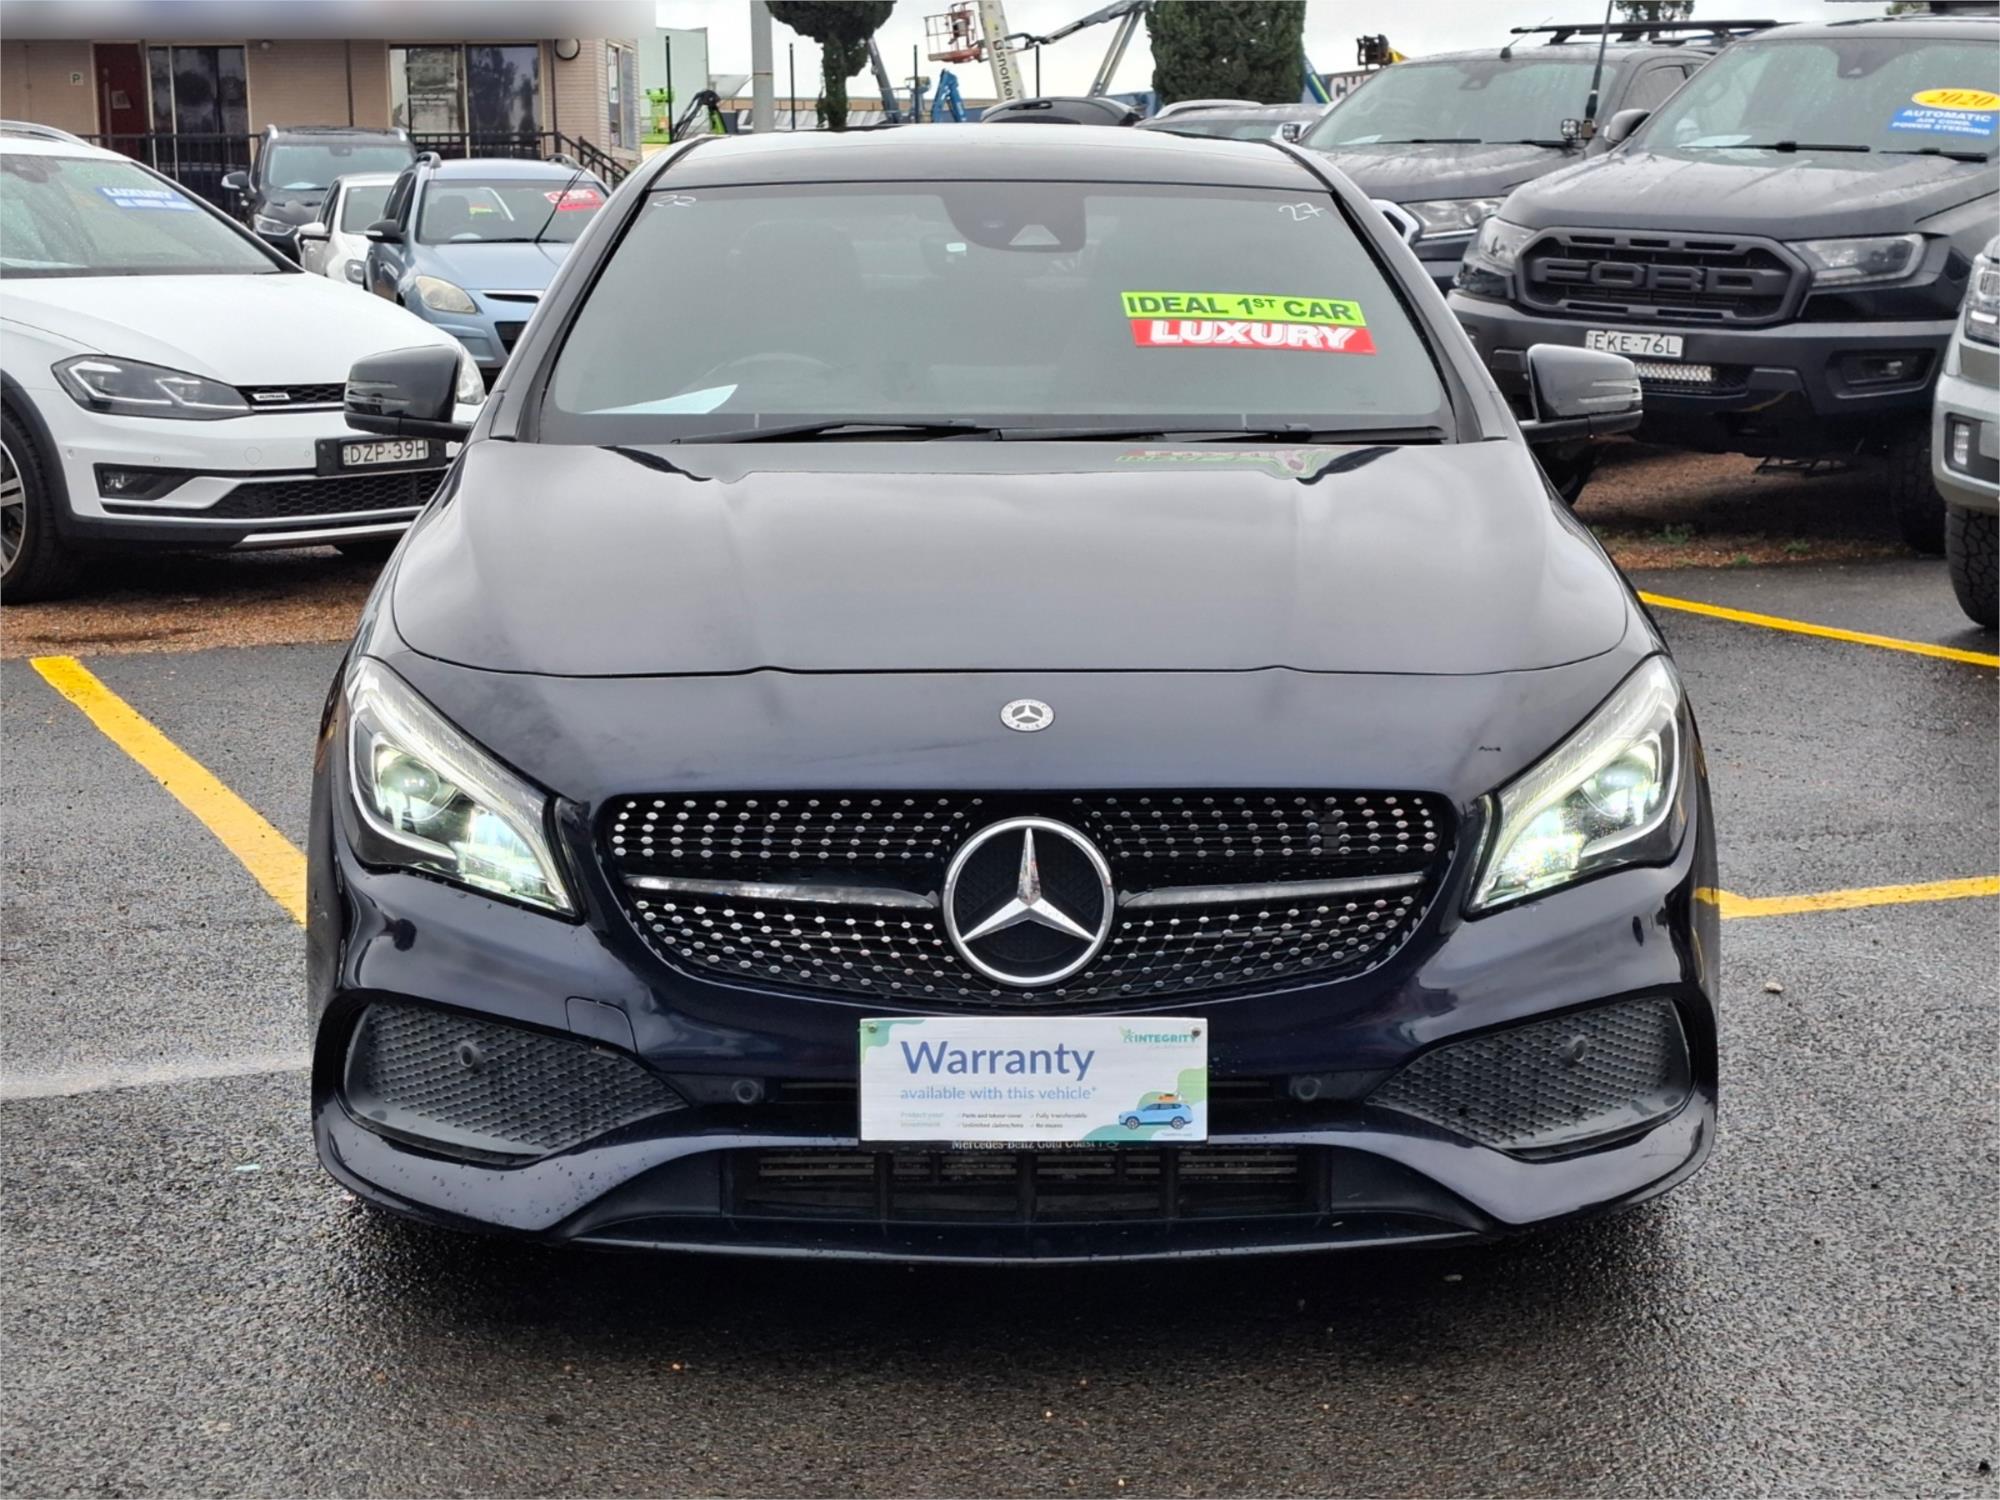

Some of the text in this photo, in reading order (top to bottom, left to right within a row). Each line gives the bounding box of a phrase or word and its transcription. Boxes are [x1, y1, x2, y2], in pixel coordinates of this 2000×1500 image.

[995, 51, 1016, 101] snorkel
[1926, 91, 1996, 107] 2020
[1902, 109, 1992, 122] AUTOMATIC
[1892, 121, 1990, 135] POWER STEERING
[1278, 202, 1325, 221] 27
[1532, 257, 1785, 295] FORD
[1126, 296, 1355, 321] IDEAL 1ST CAR
[1150, 320, 1356, 349] LUXURY
[1134, 1033, 1197, 1043] INTEGRITY
[900, 1040, 1096, 1082] Warranty
[900, 1085, 965, 1100] available
[969, 1085, 1003, 1100] with
[1007, 1085, 1034, 1100] this
